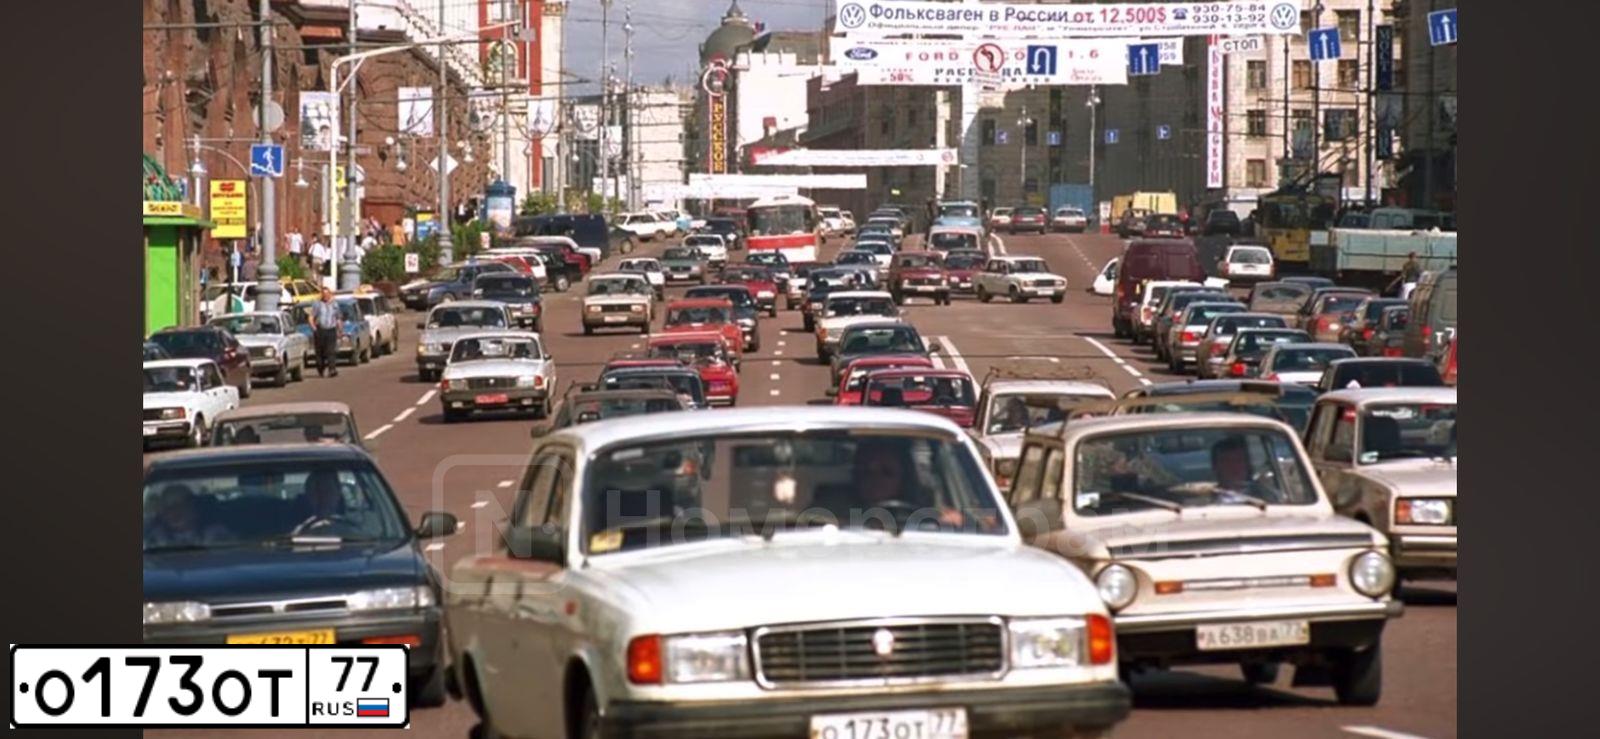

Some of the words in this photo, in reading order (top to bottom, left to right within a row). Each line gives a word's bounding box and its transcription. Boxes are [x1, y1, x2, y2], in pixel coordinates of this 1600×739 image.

[1193, 4, 1266, 12] 930-75-84
[869, 3, 984, 21] Фольксваген
[989, 11, 999, 22] в
[1005, 7, 1068, 23] России
[1100, 6, 1167, 24] 12.500$
[1193, 13, 1266, 23] 930-13-92
[1223, 38, 1258, 51] СТОП
[905, 52, 959, 61] FORD
